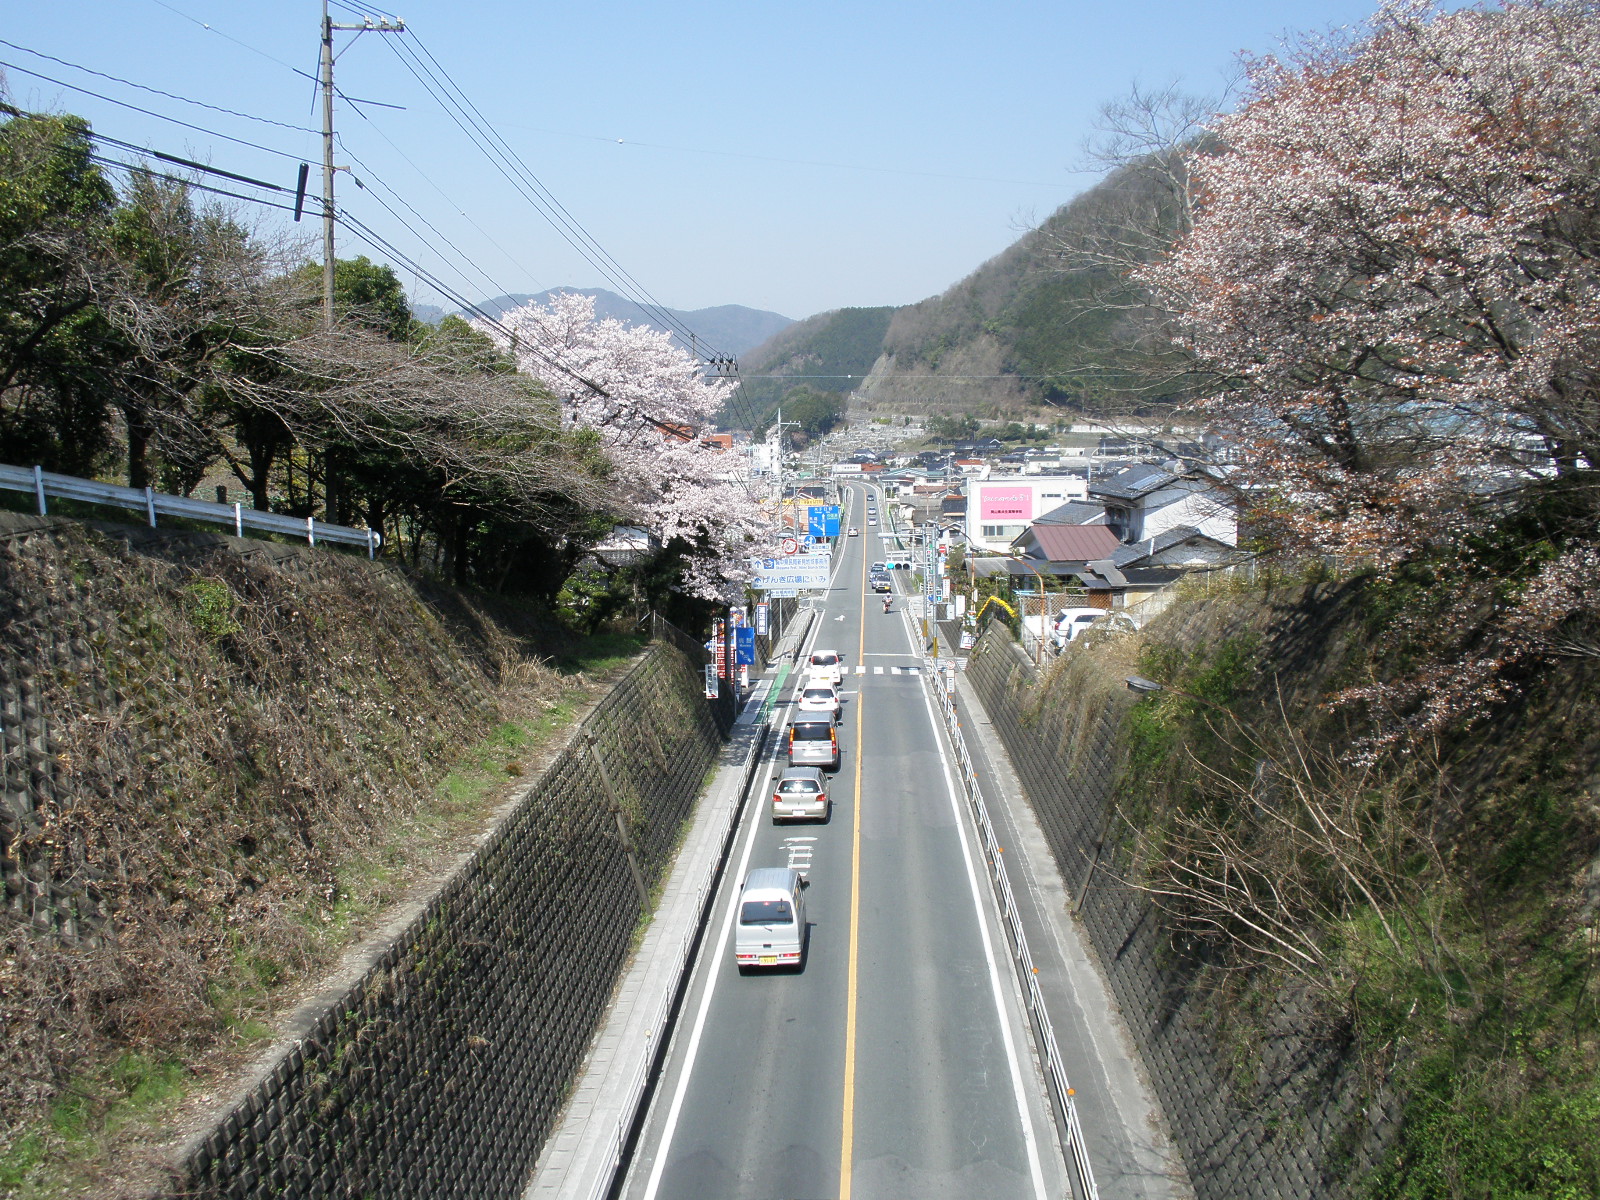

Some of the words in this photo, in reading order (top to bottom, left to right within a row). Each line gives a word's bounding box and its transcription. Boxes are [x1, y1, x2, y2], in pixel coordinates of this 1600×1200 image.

[762, 575, 827, 584] げんき広場にいみ
